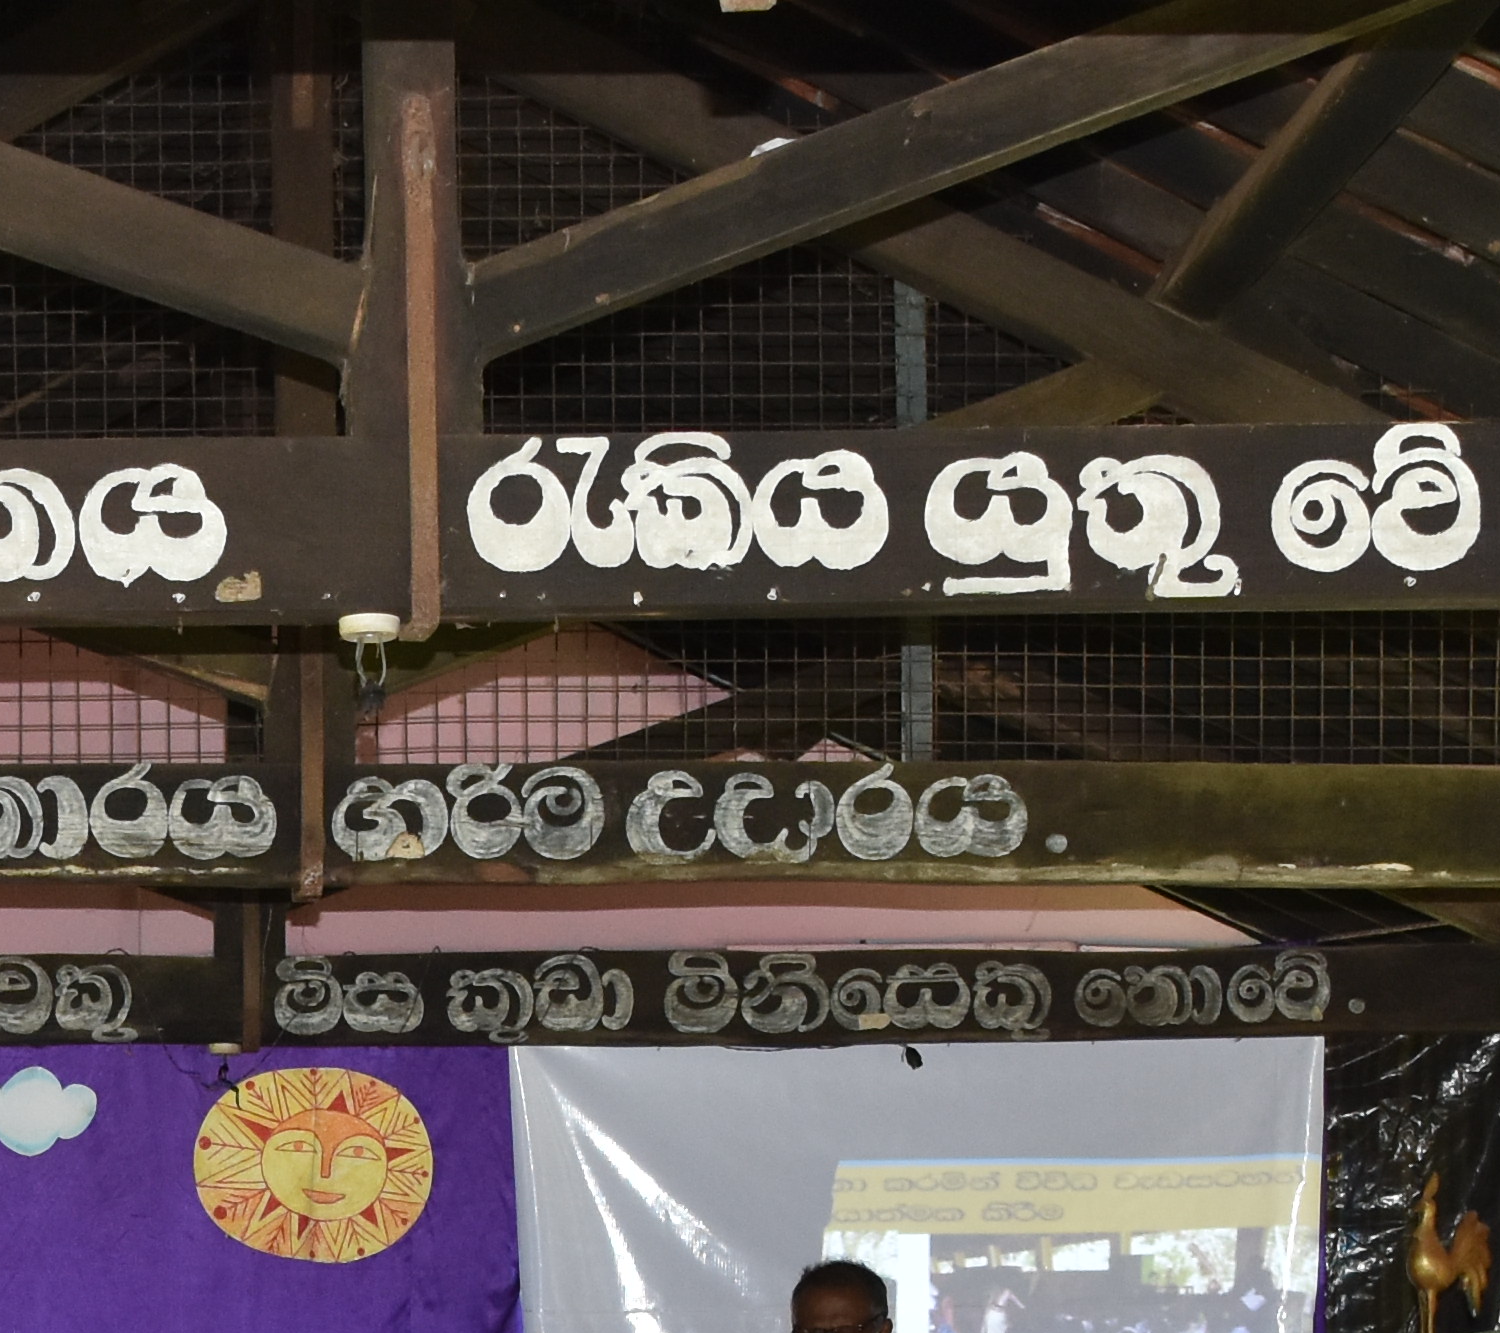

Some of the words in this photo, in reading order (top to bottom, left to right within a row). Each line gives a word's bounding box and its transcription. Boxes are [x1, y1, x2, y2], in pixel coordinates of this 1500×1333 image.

[466, 431, 889, 574] රැකිය
[923, 450, 1242, 597] යුතු
[1268, 418, 1482, 575] වේ
[274, 955, 424, 1035] මිස
[446, 953, 634, 1044] කුඩා
[664, 951, 1052, 1042] මිනිසෙකු
[1015, 1171, 1097, 1191] විවිධ
